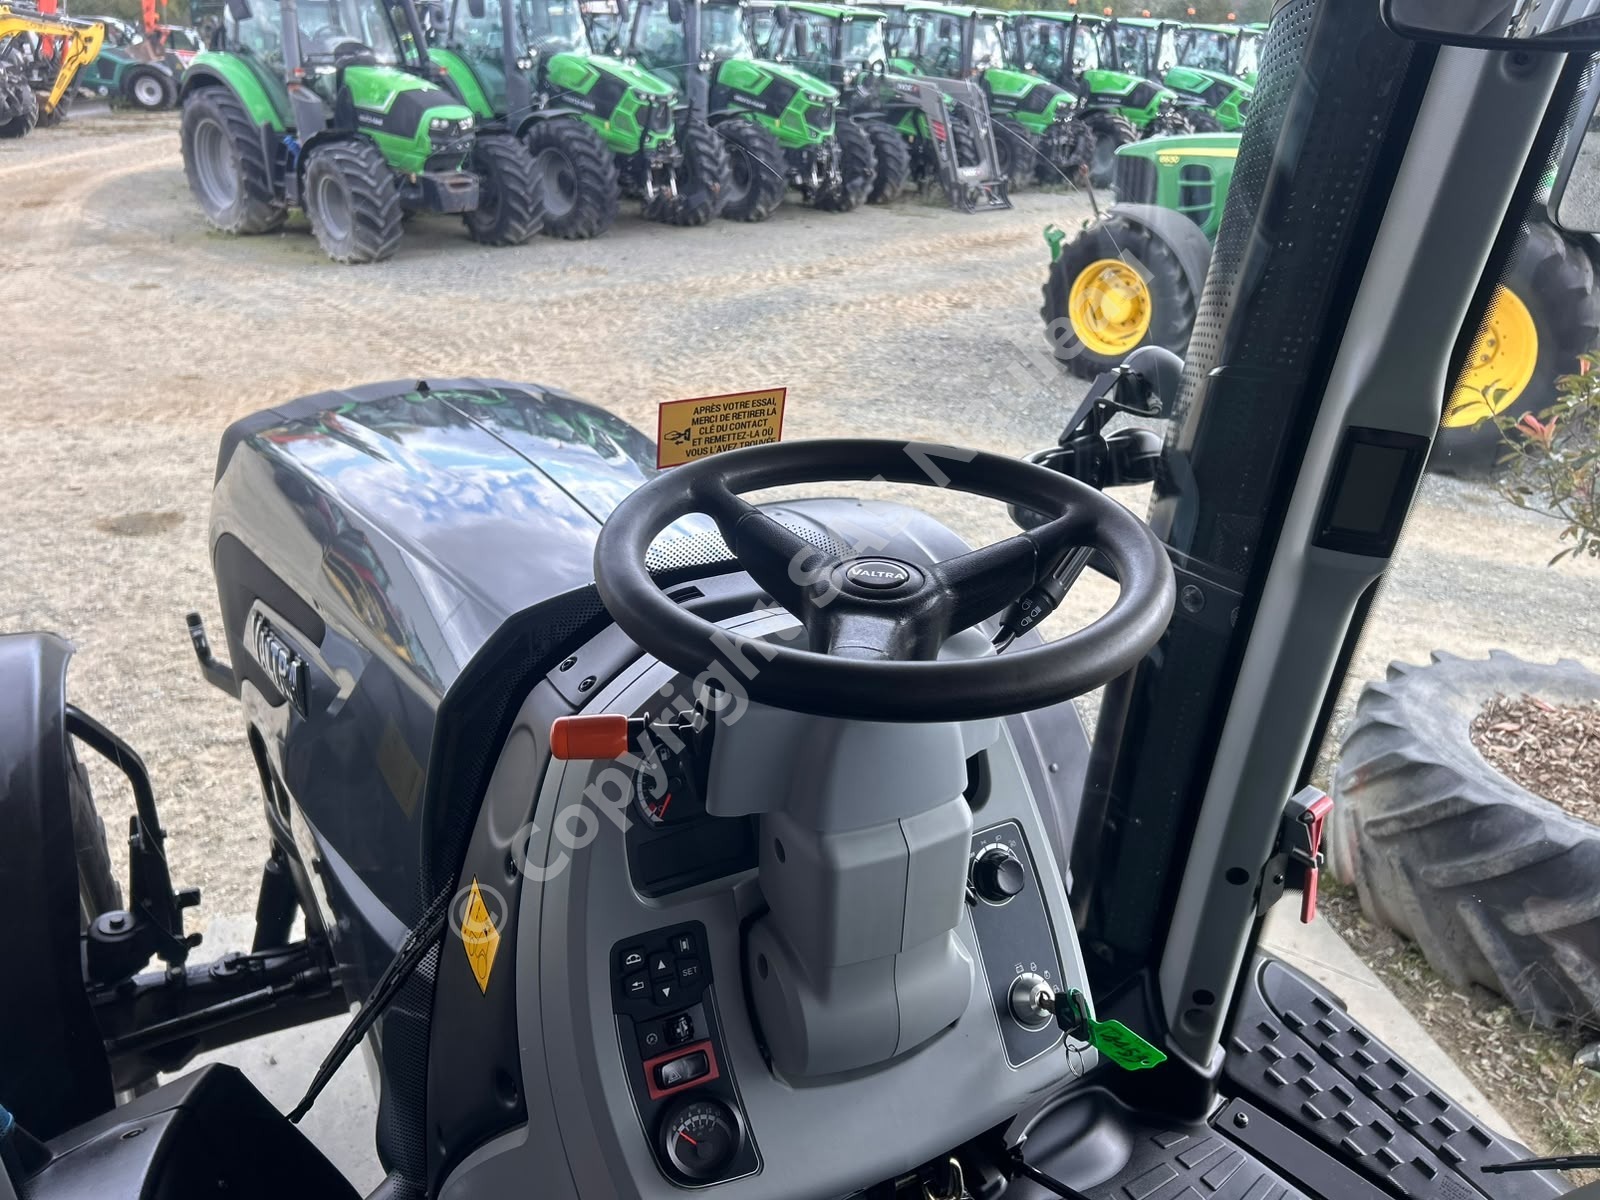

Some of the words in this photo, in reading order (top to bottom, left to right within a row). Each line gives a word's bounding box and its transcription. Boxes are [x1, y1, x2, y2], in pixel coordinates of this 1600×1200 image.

[693, 403, 721, 415] APRÈS
[723, 399, 750, 411] VOTRE
[751, 397, 777, 407] ESSAI,
[691, 415, 718, 426] MERCI
[719, 413, 730, 422] DE
[732, 410, 765, 421] RETIRER
[766, 407, 777, 416] LA
[699, 423, 714, 435] CLÉ
[716, 423, 728, 433] DU
[729, 418, 768, 431] CONTACT
[692, 437, 703, 447] ET
[704, 431, 759, 445] REMETTEZ-LA
[762, 427, 774, 437] OÙ
[685, 446, 708, 457] VOUS
[710, 442, 737, 455] L'AVEZ
[850, 568, 904, 579] VALTRA
[682, 966, 697, 977] SET
